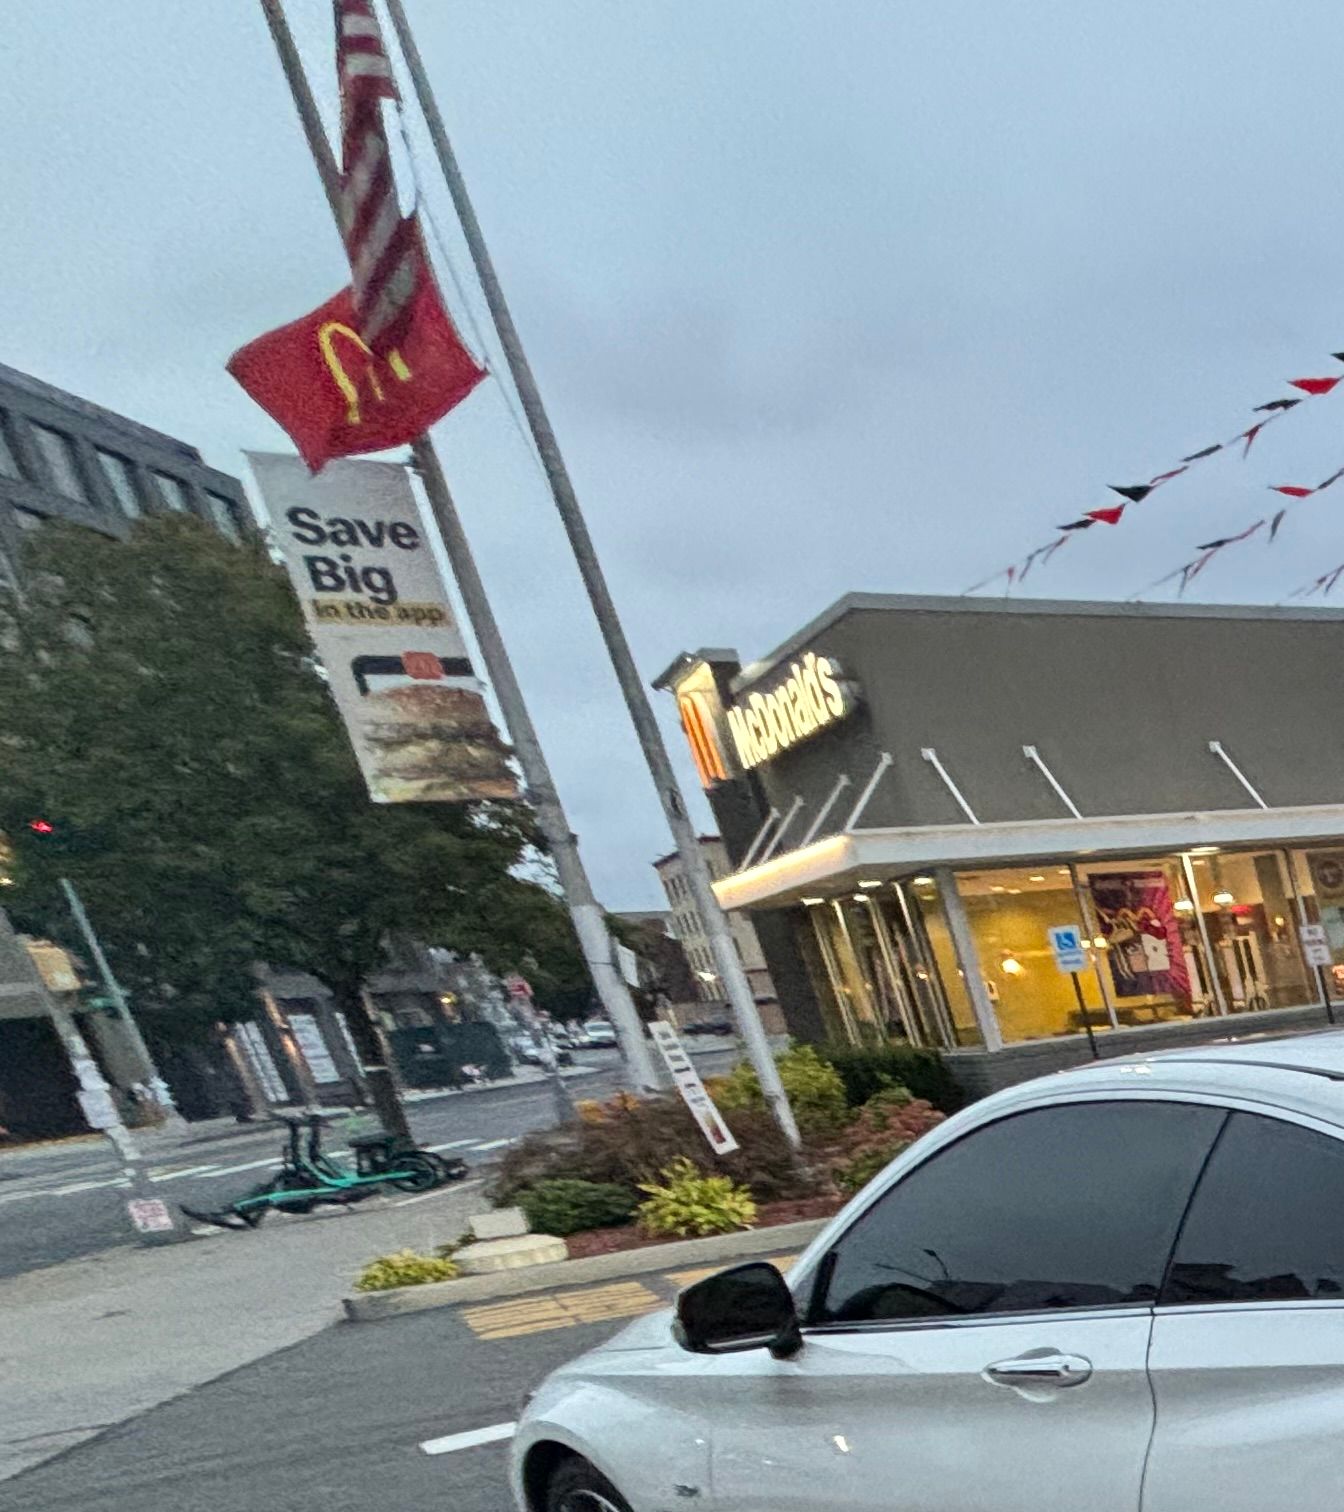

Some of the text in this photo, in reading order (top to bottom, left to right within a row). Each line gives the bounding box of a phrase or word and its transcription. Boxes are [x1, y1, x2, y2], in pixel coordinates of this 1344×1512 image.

[287, 506, 421, 550] Save
[302, 553, 398, 605] Big
[344, 602, 390, 621] the
[397, 606, 448, 627] app
[726, 651, 845, 770] McDonald's
